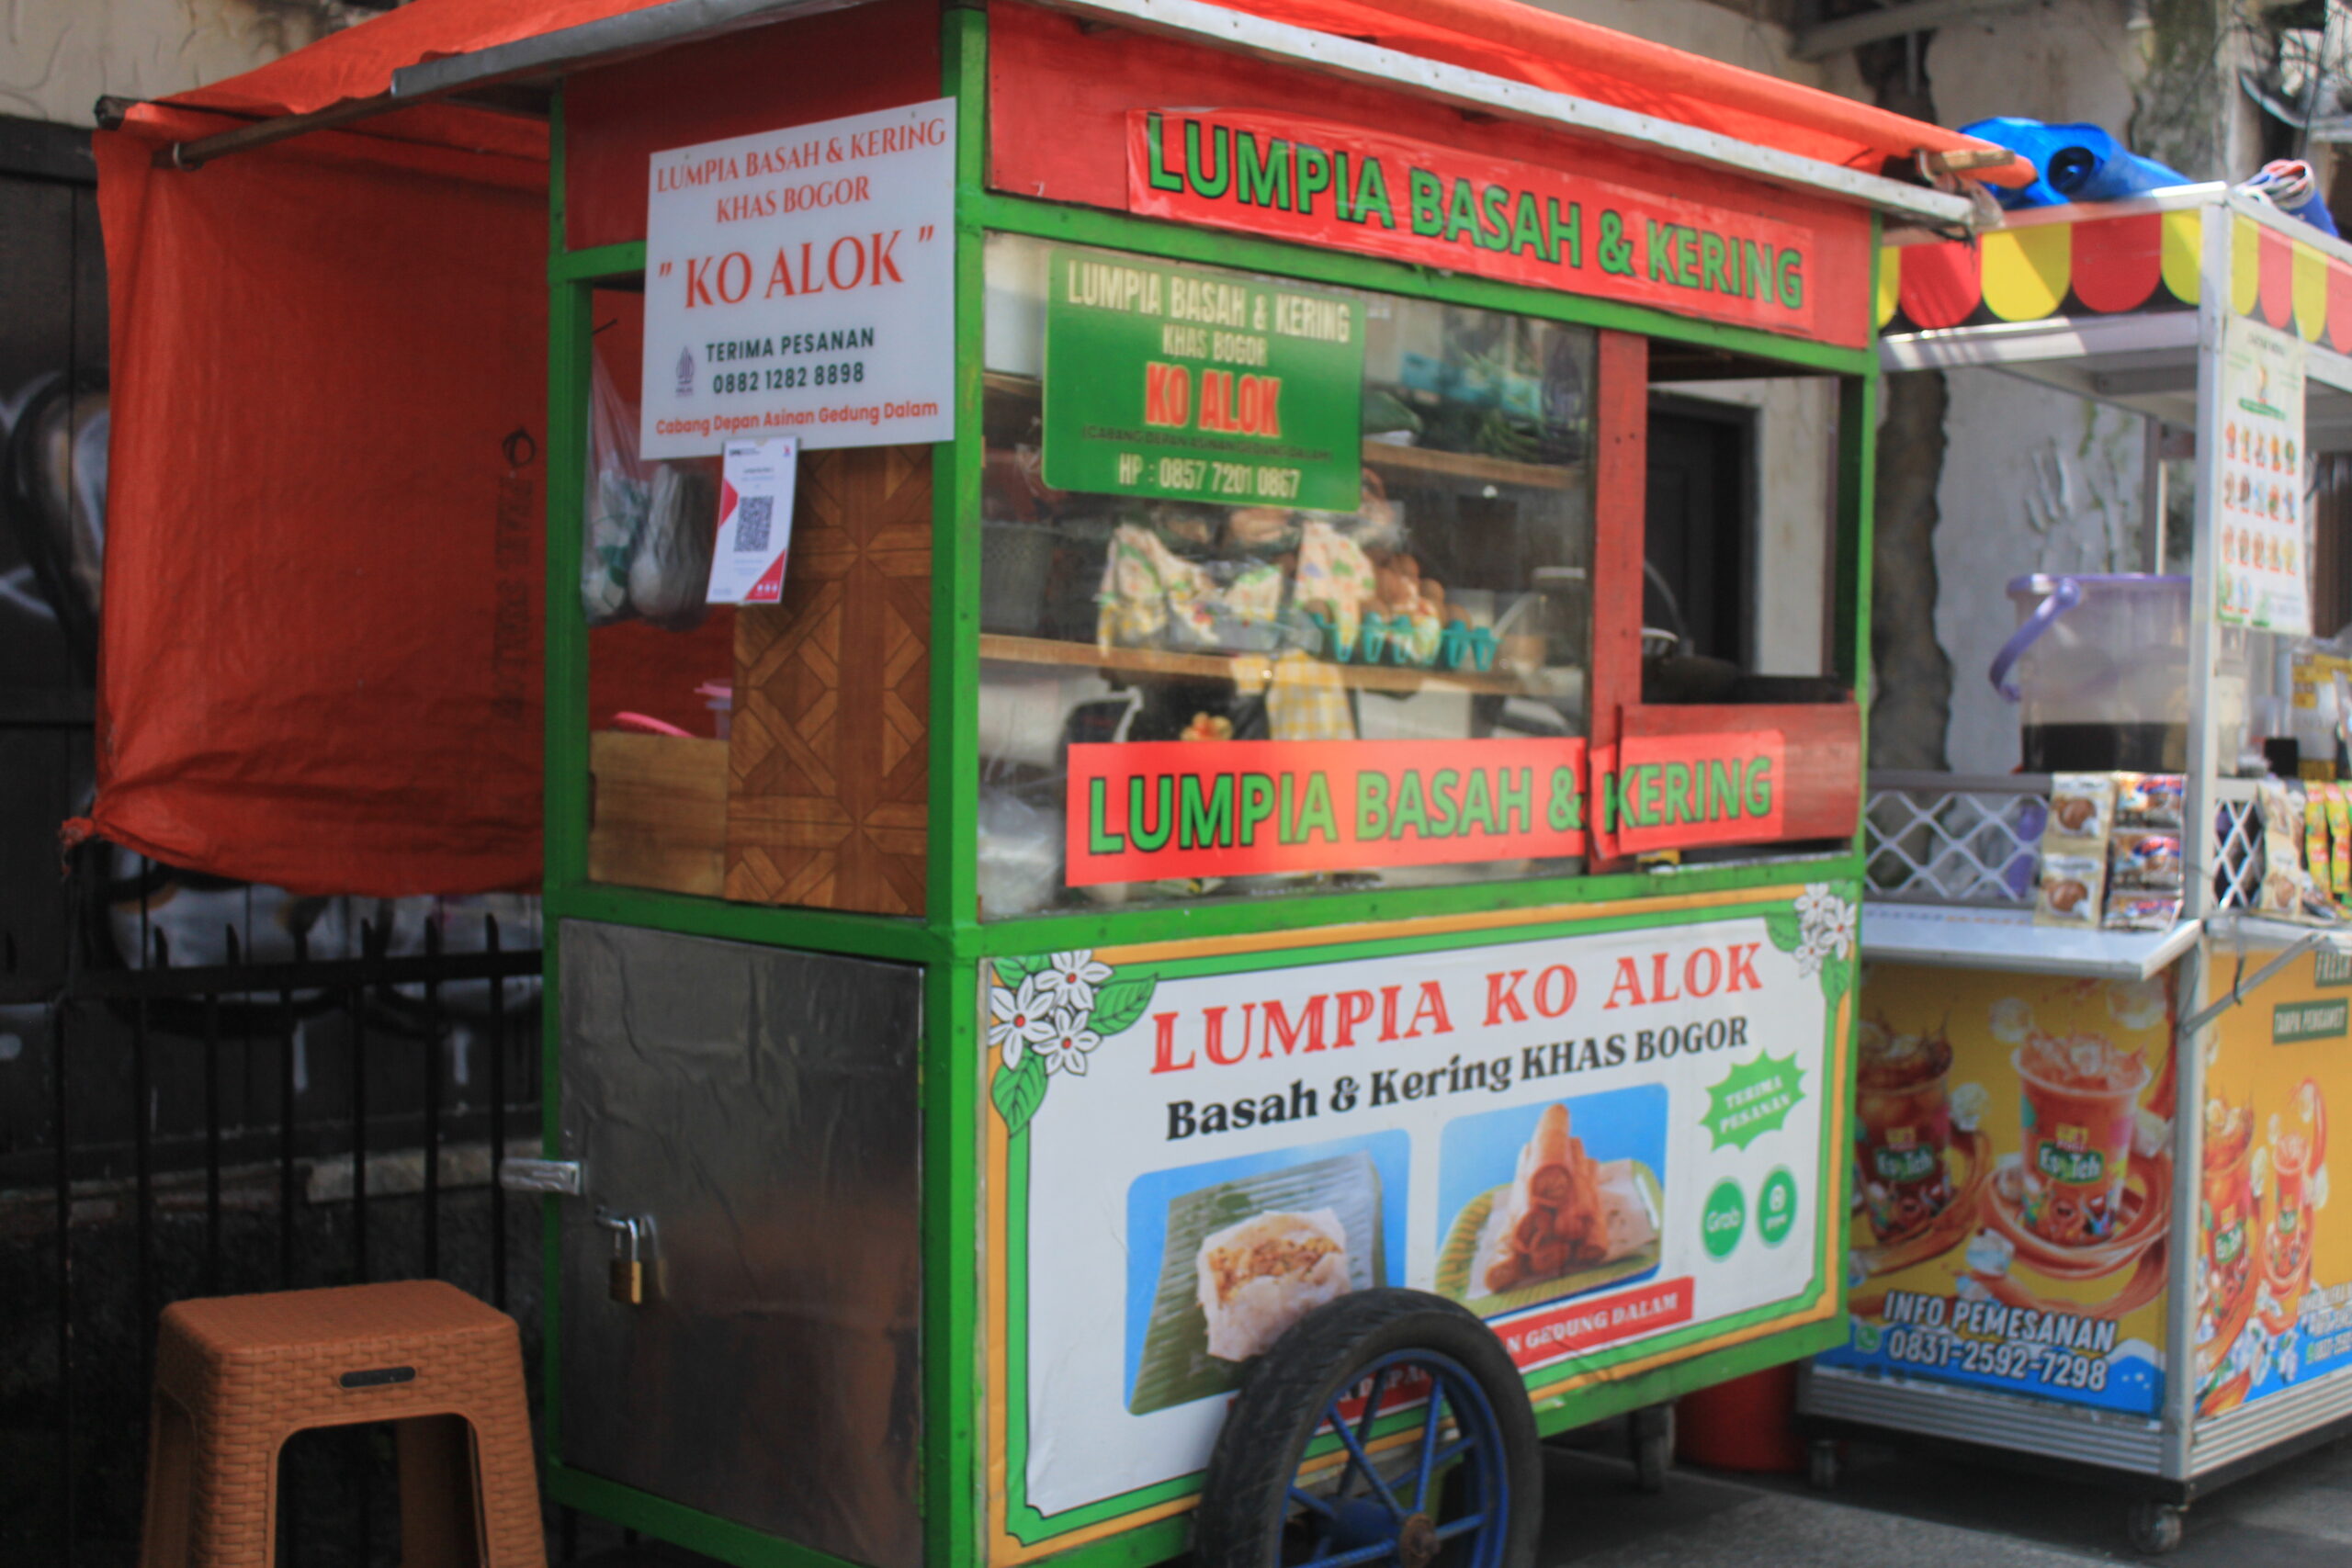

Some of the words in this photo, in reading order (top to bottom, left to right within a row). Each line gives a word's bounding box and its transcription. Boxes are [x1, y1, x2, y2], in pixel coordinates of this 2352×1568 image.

[656, 158, 740, 192] LUMPIA
[746, 141, 820, 177] BASAH
[826, 137, 843, 164] &
[850, 118, 946, 160] KERING
[717, 189, 777, 223] KHAS
[783, 175, 870, 214] BOGOR
[1147, 112, 1396, 231] LUMPIA
[1408, 166, 1582, 269] BASAH
[1598, 210, 1633, 276] &
[1645, 218, 1804, 310] KERING
[684, 251, 752, 309] KO
[763, 229, 904, 299] ALOK
[1068, 260, 1163, 317] LUMPIA
[1170, 276, 1247, 328] BASAH
[1253, 294, 1269, 332] &
[1275, 293, 1351, 344] KERING
[707, 336, 774, 363] TERIMA
[781, 327, 875, 355] PESANAN
[1162, 323, 1208, 359] KHAS
[1213, 331, 1268, 367] BOGOR
[713, 372, 758, 394] 0882
[765, 367, 807, 389] 1282
[814, 361, 864, 386] 8898
[1145, 360, 1191, 427] KO
[1198, 369, 1283, 439] ALOK
[656, 415, 710, 437] Cabang
[714, 411, 760, 433] Depan
[763, 407, 814, 426] Asinan
[819, 403, 880, 426] Gedung
[884, 400, 938, 419] Dalam
[1119, 453, 1143, 486] HP
[1159, 457, 1206, 491] 0857
[1212, 461, 1252, 495] 7201
[1088, 770, 1340, 855] LUMPIA
[1355, 766, 1532, 841] BASAH
[1548, 766, 1585, 831] &
[1604, 755, 1773, 833] KERING
[1149, 979, 1453, 1075] LUMPIA
[1482, 963, 1577, 1027] KO
[1603, 942, 1762, 1010] ALOK
[1165, 1080, 1317, 1142] Basah
[1329, 1077, 1360, 1112] &
[1368, 1054, 1512, 1108] Kering
[1520, 1033, 1627, 1080] KHAS
[1634, 1016, 1748, 1064] BOGOR
[1724, 1075, 1782, 1110] TERIMA
[1720, 1092, 1791, 1134] PESANAN
[1706, 1206, 1742, 1233] Grab
[1525, 1310, 1608, 1349] GEDUNG
[1611, 1292, 1679, 1326] DALAM
[1884, 1290, 1946, 1326] INFO
[1951, 1300, 2117, 1353] PEMESANAN
[1888, 1330, 2109, 1392] 0831-2592-7298
